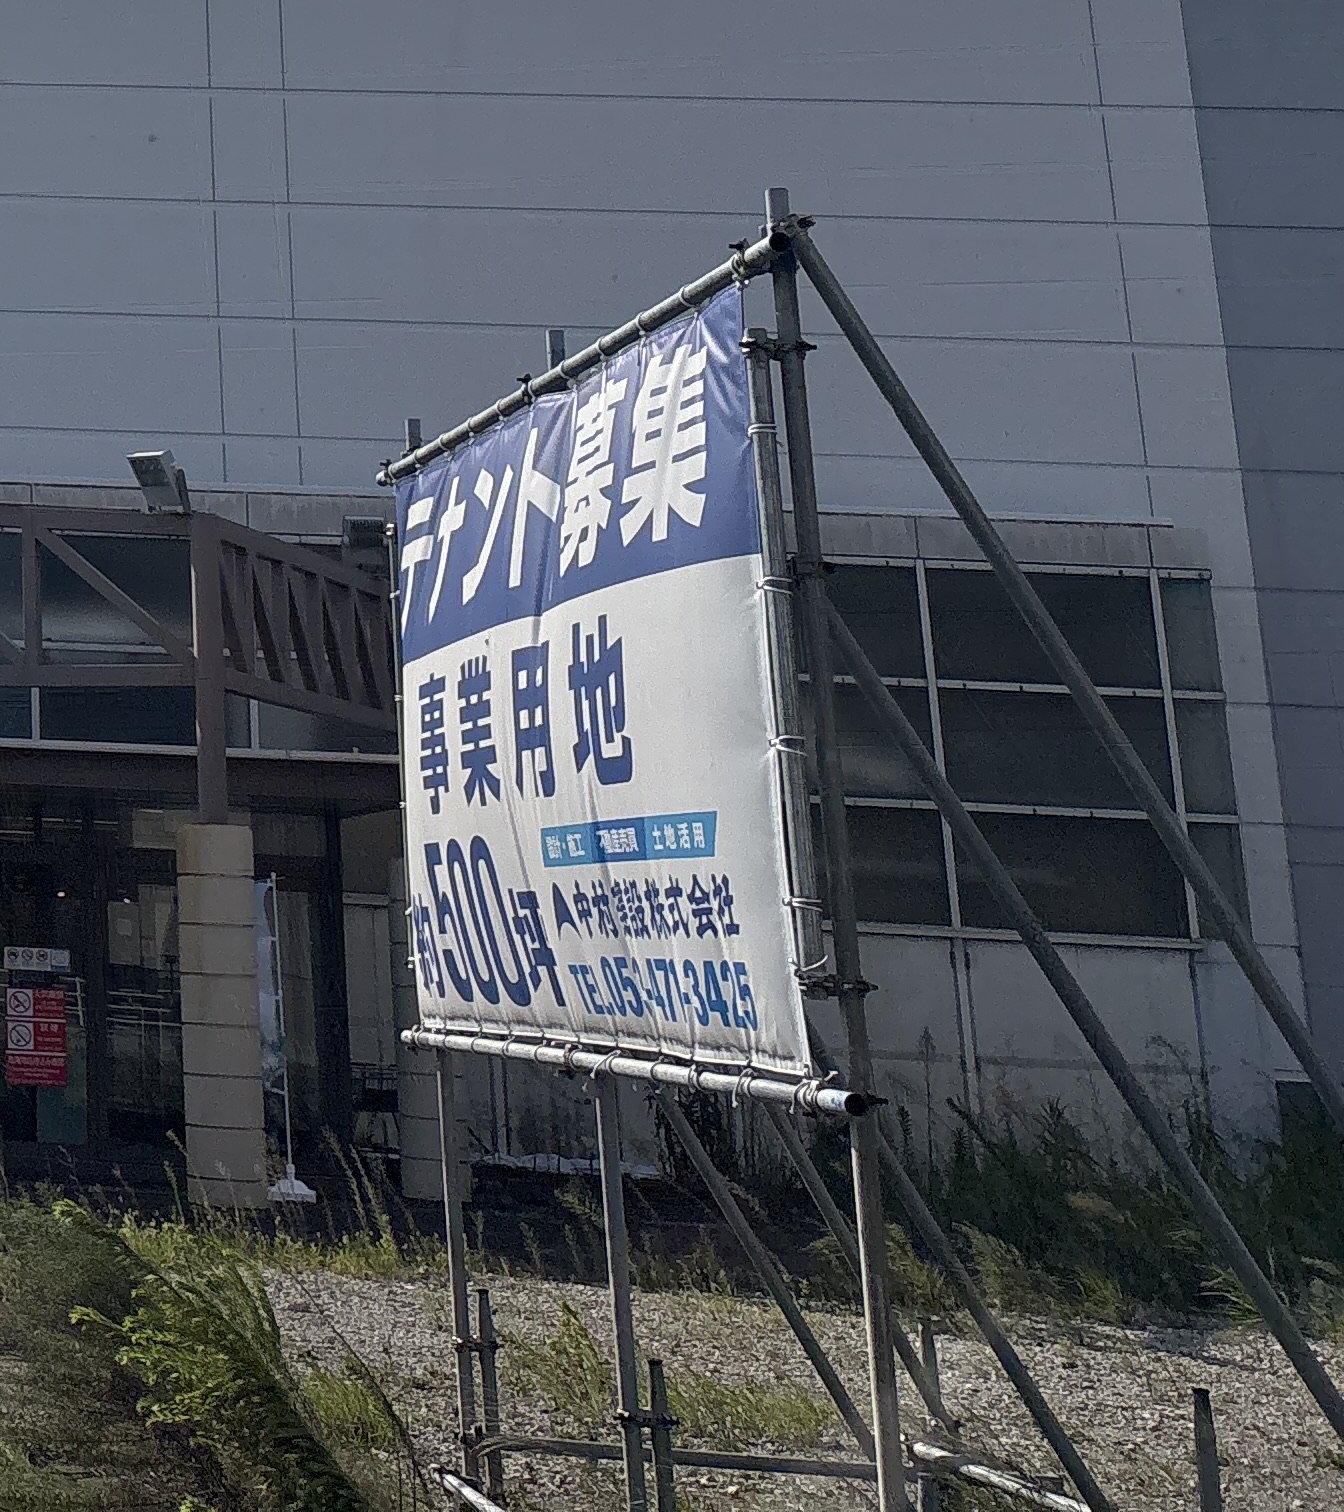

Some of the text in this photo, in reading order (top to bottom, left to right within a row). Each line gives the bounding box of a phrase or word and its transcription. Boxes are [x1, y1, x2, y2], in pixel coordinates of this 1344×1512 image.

[400, 343, 708, 638] テナント募集
[418, 613, 634, 815] 事業用地
[412, 834, 567, 1007] 約500坪
[651, 821, 706, 851] 土地活用
